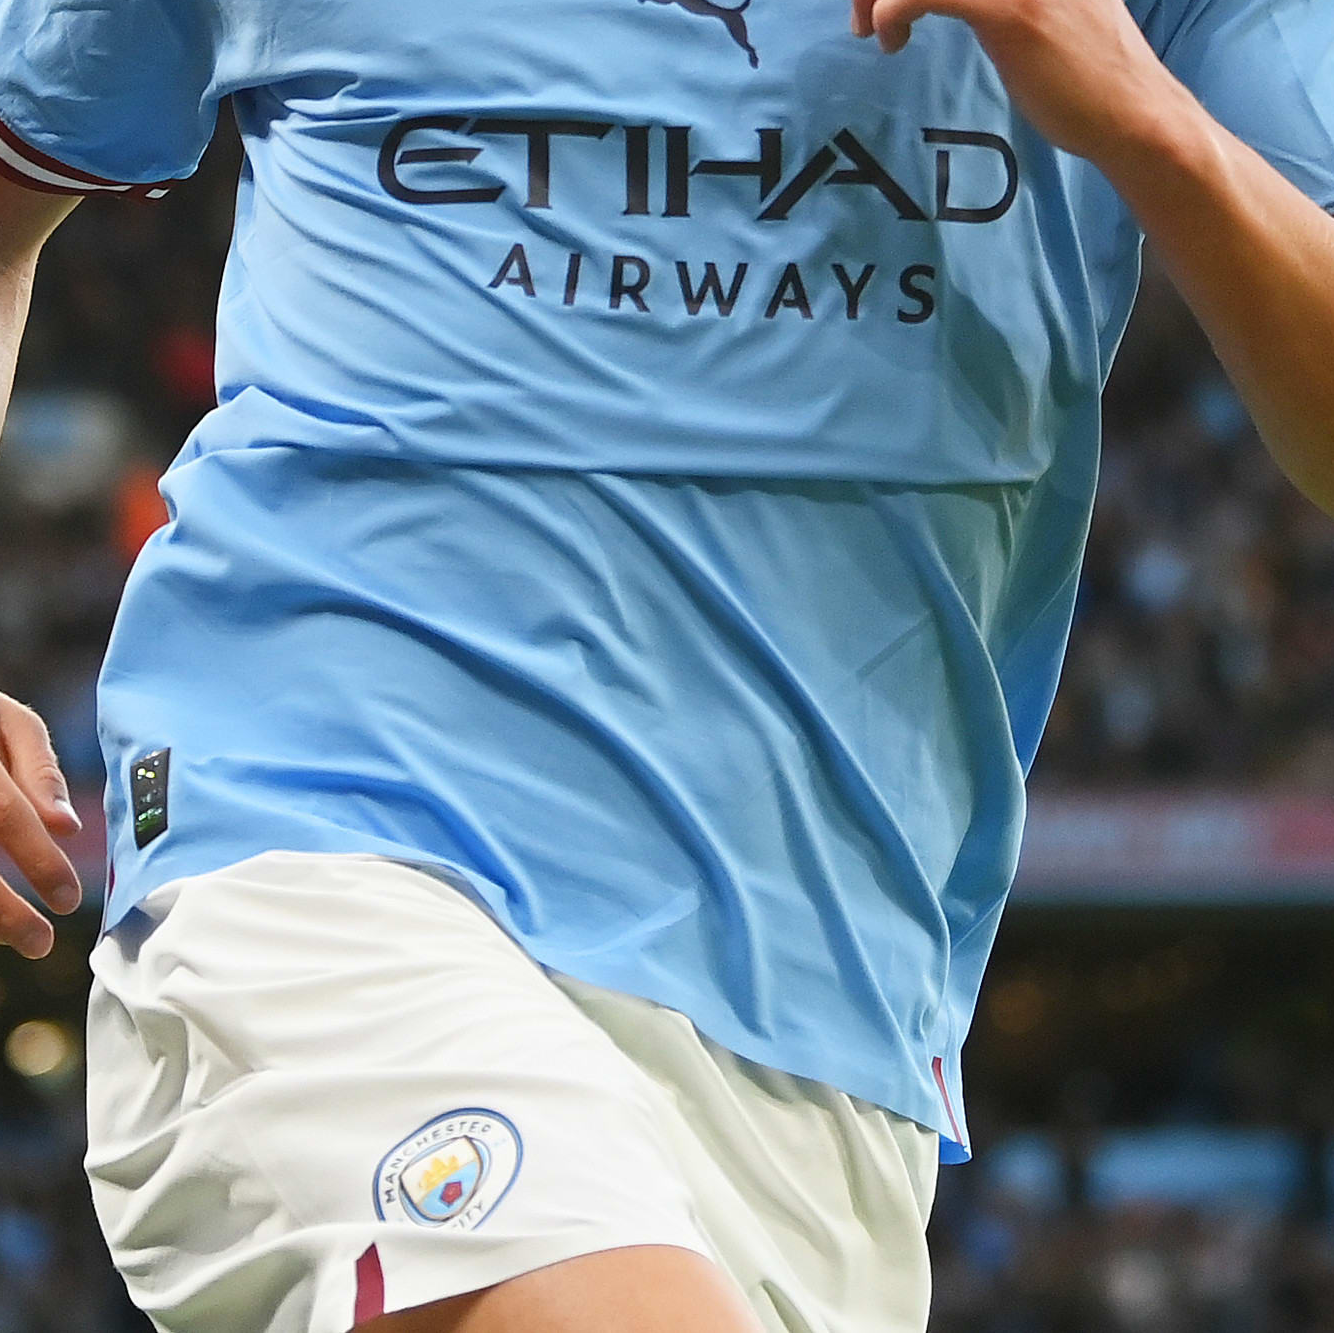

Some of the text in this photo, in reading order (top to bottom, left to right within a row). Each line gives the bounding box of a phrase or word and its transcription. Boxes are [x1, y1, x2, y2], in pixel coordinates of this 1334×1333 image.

[377, 116, 1019, 224] ETIHAD
[487, 242, 936, 325] AIRWAYS
[452, 1200, 484, 1229] ITY
